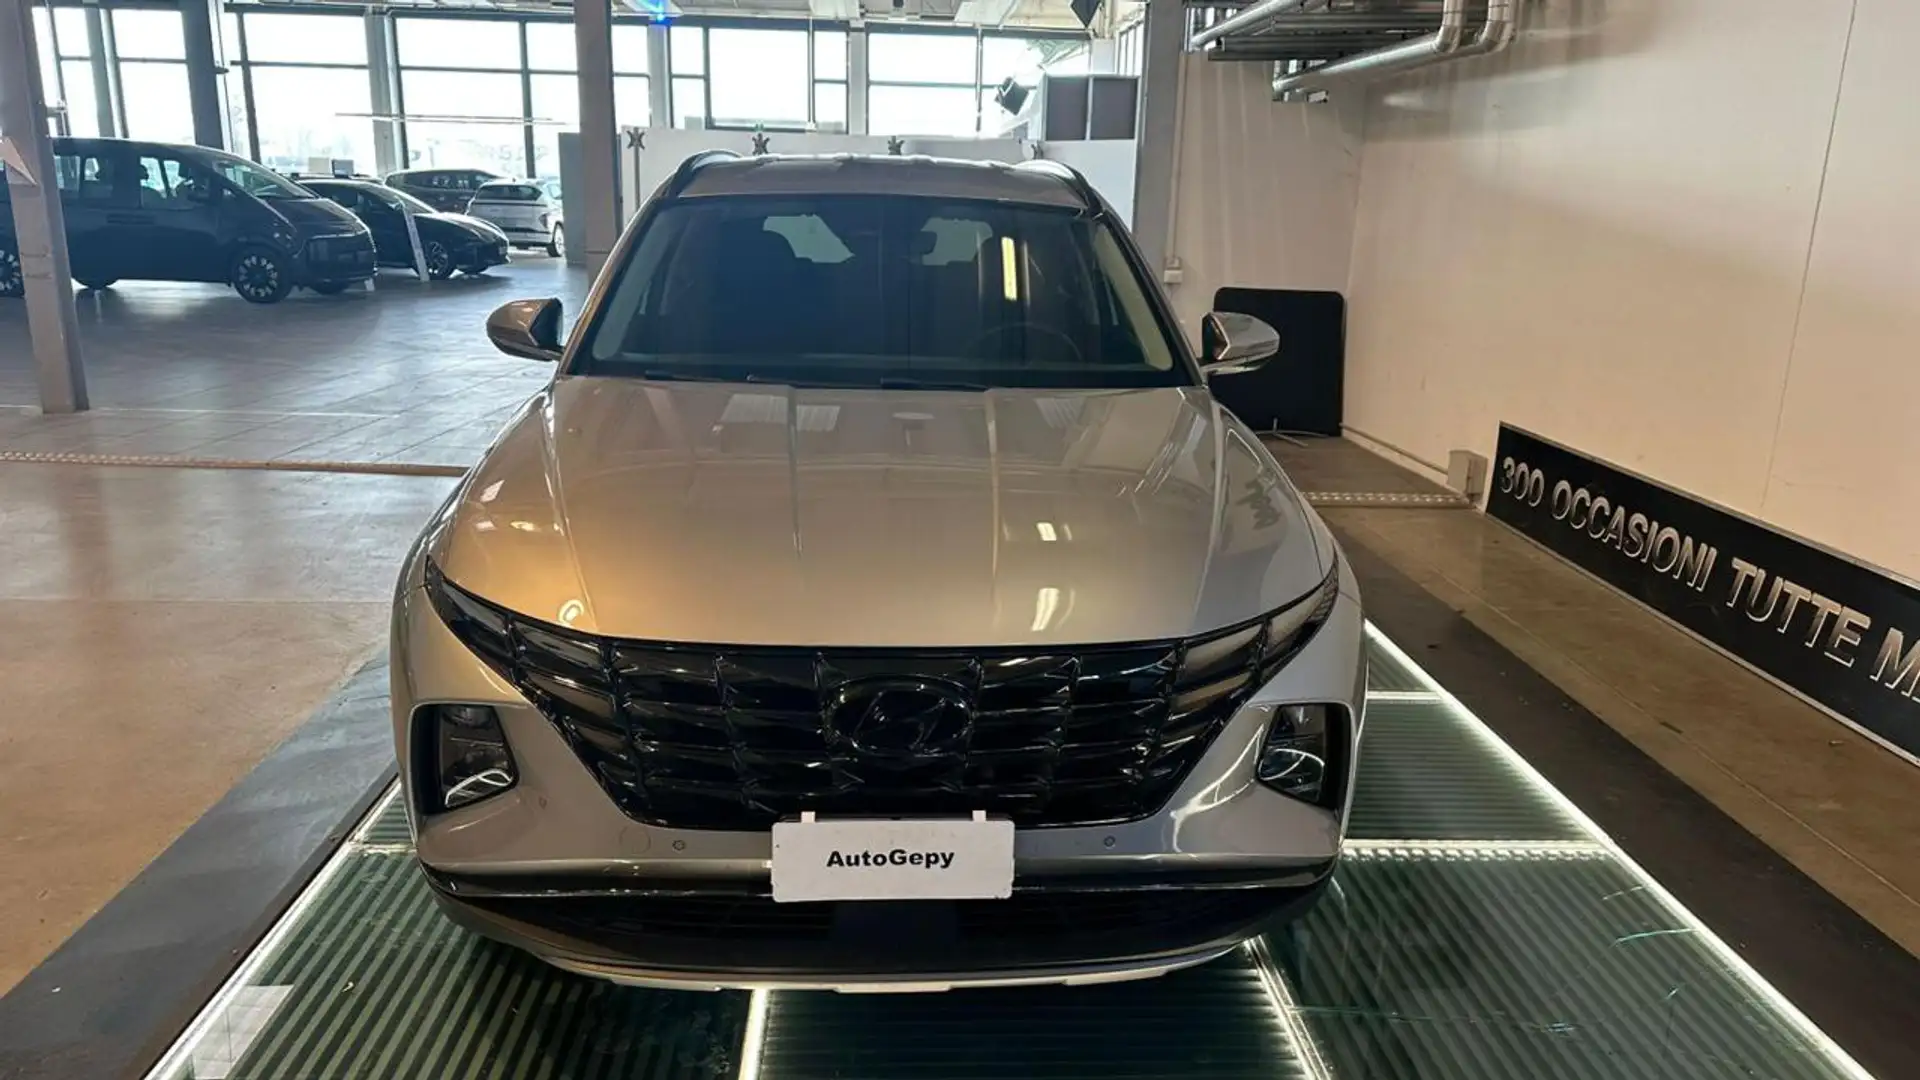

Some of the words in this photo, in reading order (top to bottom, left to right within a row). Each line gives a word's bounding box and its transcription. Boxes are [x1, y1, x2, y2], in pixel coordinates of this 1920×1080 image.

[1502, 456, 1544, 507] 300
[1552, 480, 1717, 592] OCCASIONI
[1727, 557, 1871, 667] TUTTE
[1869, 627, 1920, 703] M
[826, 849, 954, 869] AutoGepy
